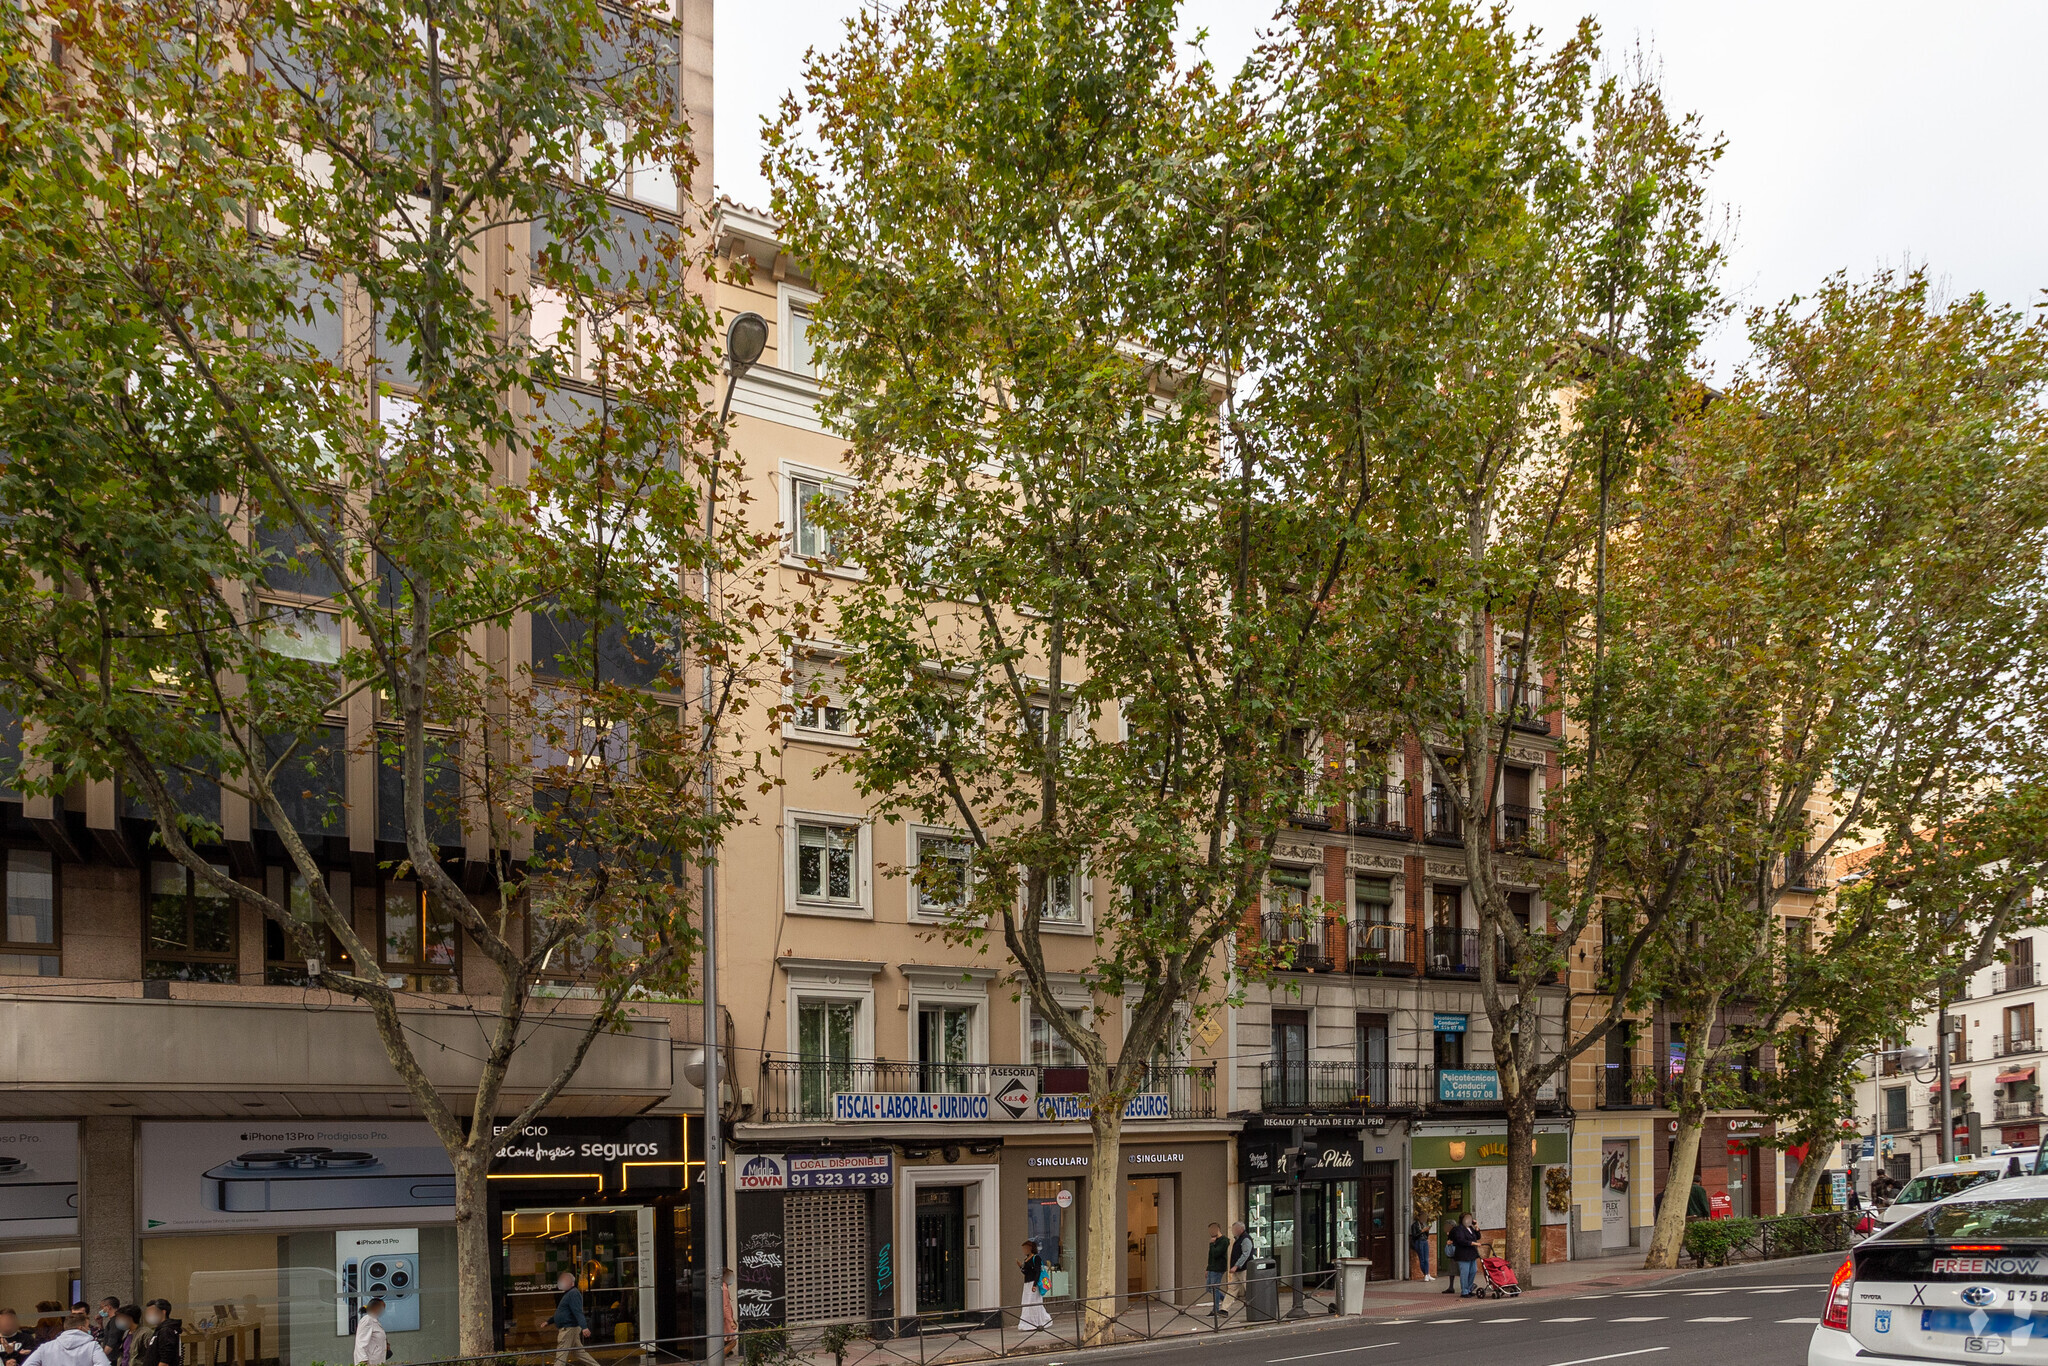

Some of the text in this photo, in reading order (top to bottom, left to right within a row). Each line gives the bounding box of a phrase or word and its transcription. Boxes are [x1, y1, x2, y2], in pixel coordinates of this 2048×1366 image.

[990, 1068, 1036, 1077] ASESORIA
[1442, 1072, 1496, 1082] Psicotécnicos
[1452, 1081, 1487, 1090] Conducir
[1445, 1090, 1493, 1098] 91 415 07 08
[837, 1095, 988, 1119] FISCAL LABORAL JURIDICO
[1263, 1118, 1296, 1126] REGALOS
[1309, 1118, 1331, 1126] PLATA
[1332, 1118, 1342, 1126] DE
[1343, 1118, 1356, 1126] LEY
[1357, 1118, 1366, 1126] AL
[1367, 1117, 1384, 1125] PESO
[249, 1131, 390, 1142] iPhone 13 Pro Prodigioso Pro.
[506, 1145, 535, 1158] Corte
[535, 1142, 576, 1162] Inglés
[580, 1142, 659, 1162] seguros
[794, 1157, 886, 1170] LOCAL DISPONIBLE
[1036, 1157, 1089, 1167] SINGULARU
[1135, 1153, 1185, 1164] SINGULARU
[1323, 1149, 1355, 1168] Plata
[748, 1158, 775, 1176] Middle
[740, 1176, 783, 1187] TOWN
[791, 1172, 889, 1186] 91 323 12 39
[1605, 1202, 1618, 1210] FLEX
[1933, 1258, 2040, 1274] FREENOW
[1909, 1284, 1928, 1305] X
[1969, 1339, 2001, 1353] SP
